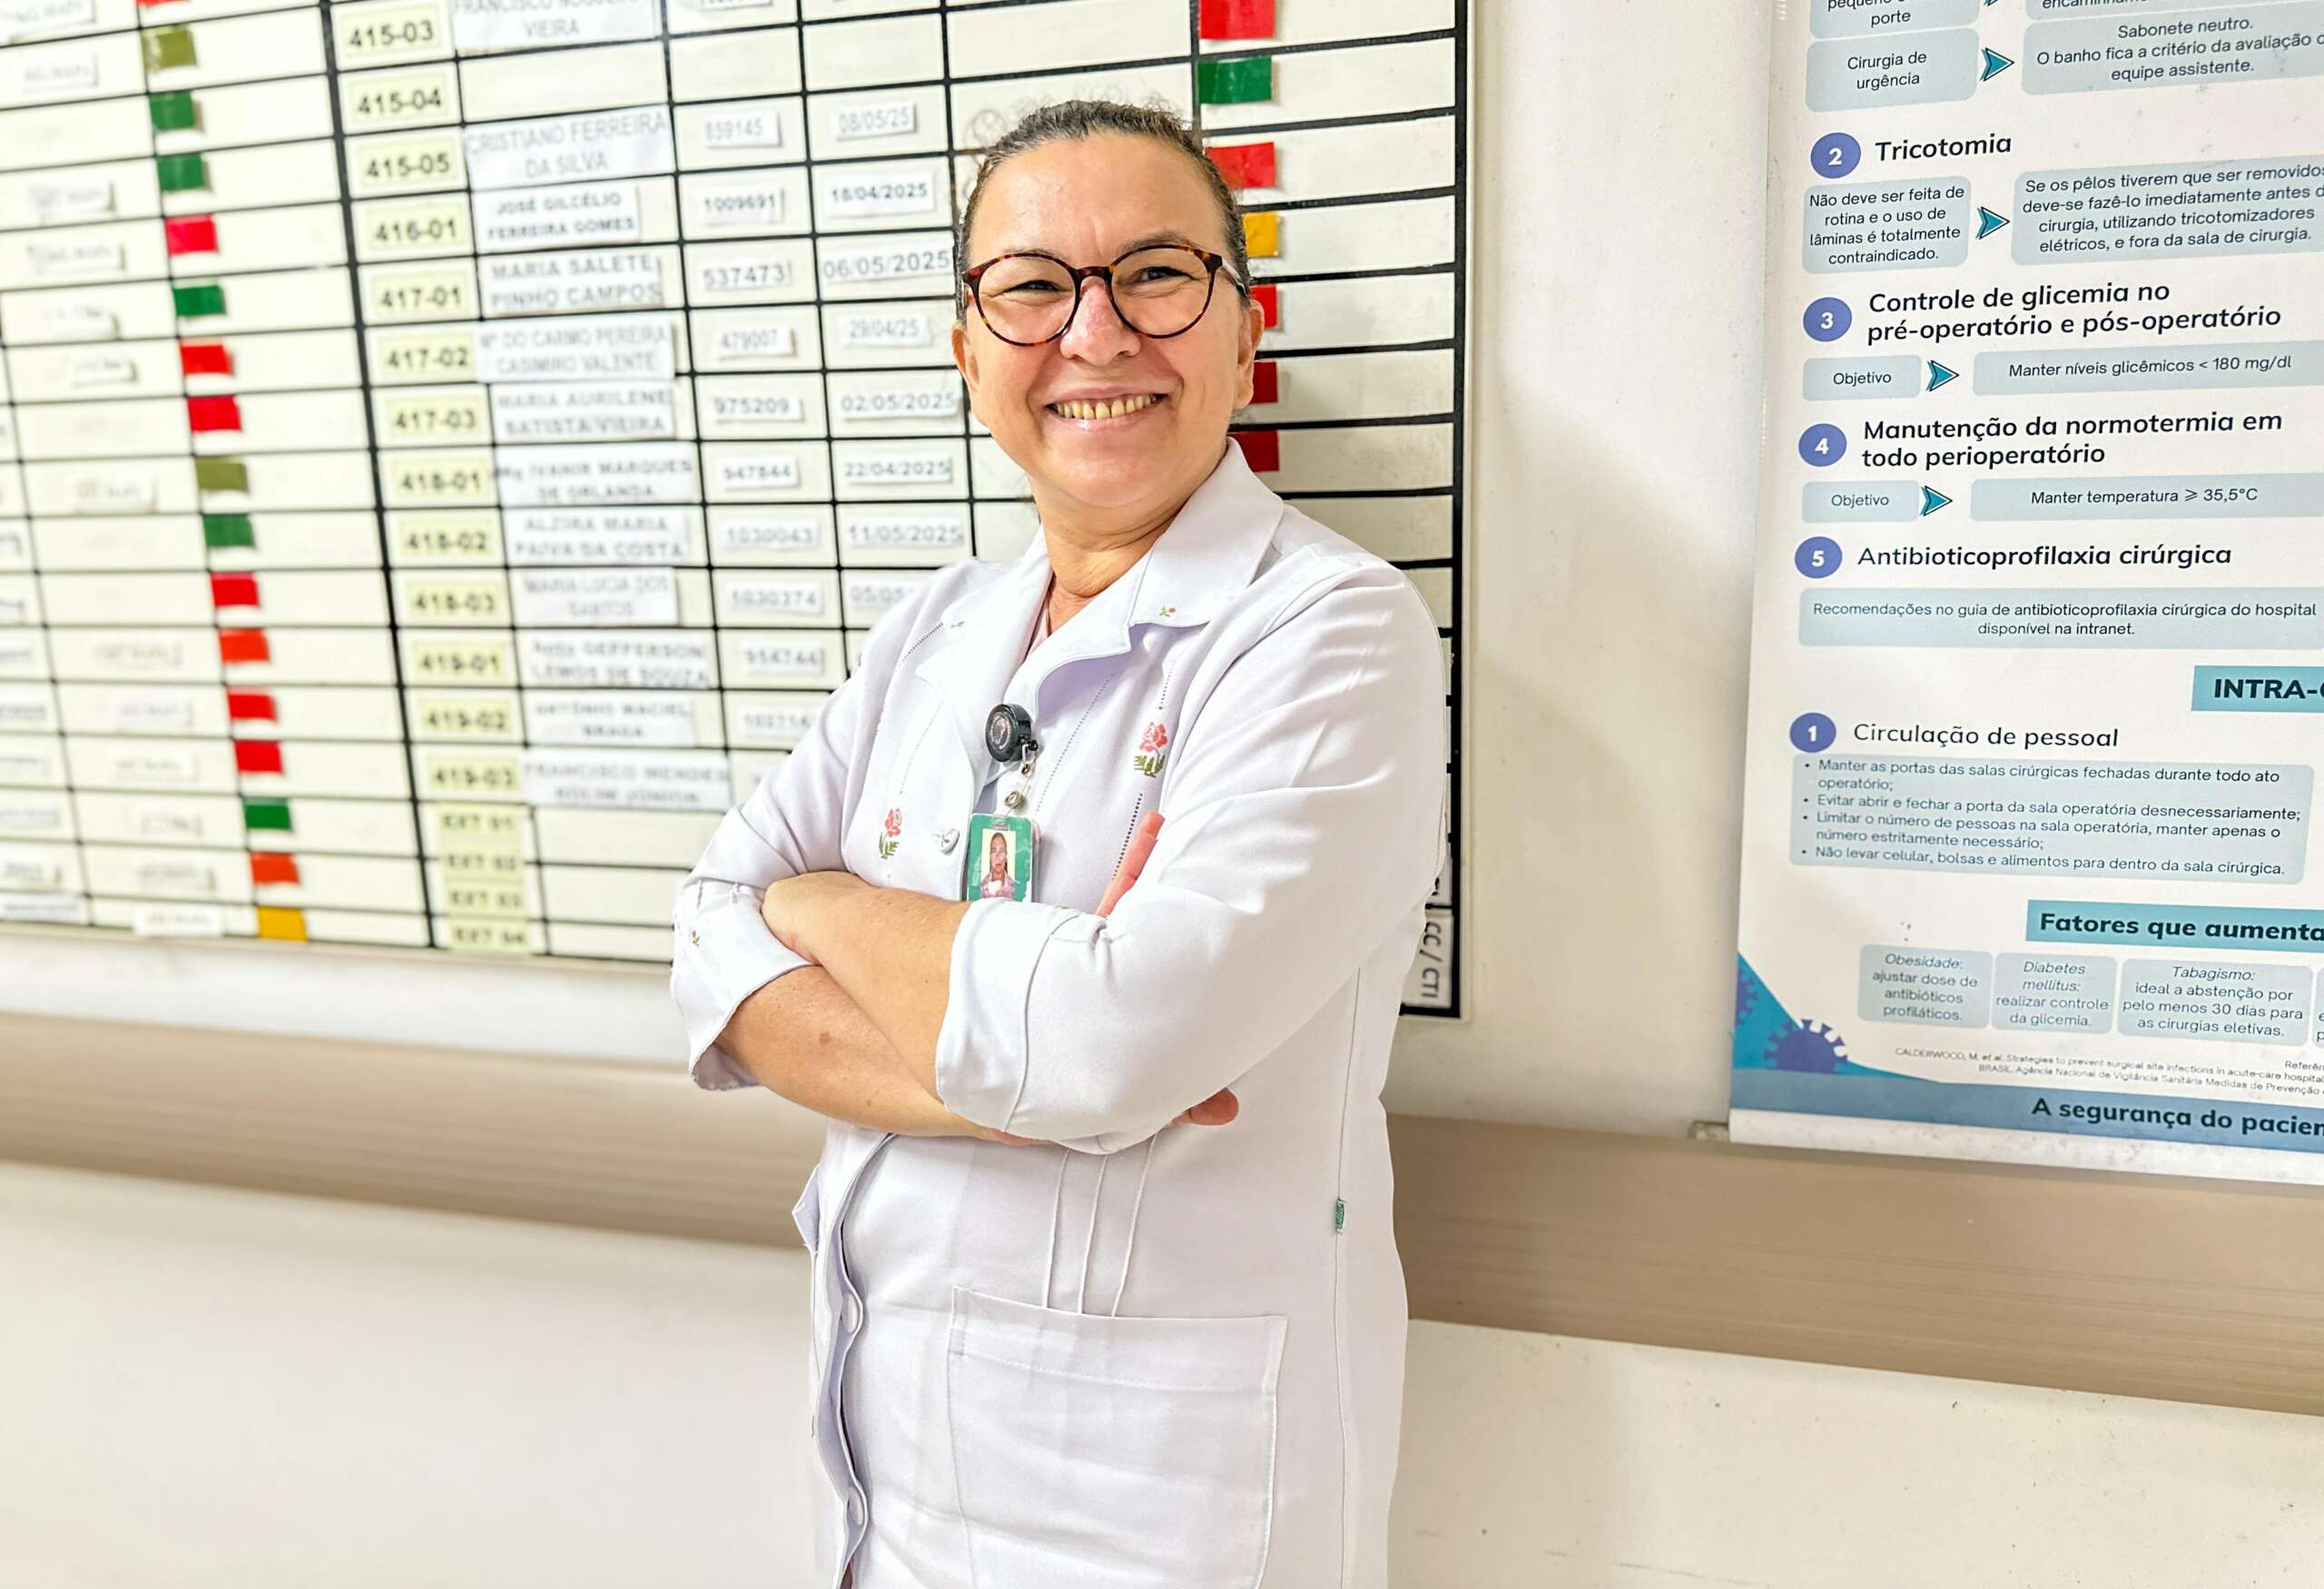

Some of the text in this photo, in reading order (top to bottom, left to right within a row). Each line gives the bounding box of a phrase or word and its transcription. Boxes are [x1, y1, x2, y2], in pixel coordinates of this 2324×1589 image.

[350, 20, 433, 47] 415-03
[2118, 18, 2253, 39] Sabonete neutro.
[2152, 43, 2206, 58] critério
[2235, 34, 2310, 51] avaliação
[1847, 54, 1903, 72] Cirurgia
[2112, 60, 2254, 83] equipe assistente.
[1856, 74, 1920, 91] urgência
[358, 89, 442, 115] 415-04
[1828, 133, 2012, 165] 2 Tricotomia
[366, 153, 449, 180] 415-05
[2122, 173, 2178, 187] tiverem
[1809, 188, 1941, 206] Não feita
[2023, 189, 2310, 212] deve-se fazê-lo imediatamente antes
[1825, 212, 1865, 225] rotina
[2039, 208, 2314, 233] cirurgia, utilizando tricotomizadores
[375, 219, 458, 242] 416-01
[1809, 228, 1960, 246] lâminas totalmente
[2040, 227, 2311, 252] elétricos, cirurgia.
[823, 251, 950, 279] 06/05/2025
[1828, 249, 1938, 264] contraindicado.
[381, 287, 461, 308] 417-01
[1821, 282, 2128, 329] 3 Controle glicemia
[1867, 305, 2281, 345] pré-operatório pós-operatório
[387, 346, 469, 370] 417-02
[2009, 357, 2240, 376] Manter níveis glicêmicos 180
[1833, 371, 1891, 387] Objetivo
[396, 410, 477, 429] 417-03
[1815, 411, 2233, 454] 4 Manutenção normotermia
[1926, 443, 2105, 470] perioperatório
[1831, 495, 1889, 508] Objetivo
[2032, 488, 2258, 505] Manter temperatura 35,5°C
[1812, 544, 2231, 569] 5 Antibioticoprofilaxia cirúrgica
[1814, 604, 2316, 618] Recomendações antibioticoprofilaxia cirúrgica hospital
[1978, 623, 2134, 636] disponível intranet.
[2214, 679, 2324, 699] INTRA-
[1808, 724, 2118, 749] 1 Circulação pessoal
[1819, 760, 2211, 781] Manter portas cirúrgicas fechadas durante
[1818, 779, 1893, 791] operatório;
[1817, 794, 2300, 821] Evitar fechar operatória desnecessariamente;
[1817, 813, 2266, 839] Limitar número pessoas operatória, manter apenas
[1817, 830, 2043, 850] número estritamente necessário;
[1816, 846, 2285, 876] Não celular, bolsas alimentos dentro cirúrgica.
[2041, 913, 2139, 934] Fatores
[1886, 953, 1963, 970] Obesidade:
[2024, 962, 2085, 974] Diabetes
[1422, 968, 1440, 998] CTI
[1872, 972, 1917, 984] ajustar
[2172, 966, 2256, 982] Tabagismo:
[1885, 988, 1964, 1003] antibióticos
[2023, 980, 2081, 992] mellitus:
[2187, 987, 2263, 1000] abstenção
[1883, 1005, 1962, 1022] profiláticos.
[1997, 996, 2109, 1011] realizar controle
[2211, 1003, 2230, 1015] 30
[2031, 1013, 2091, 1027] glicemia.
[2158, 1018, 2284, 1037] cirurgias eletivas.
[2007, 1054, 2053, 1064] Strategies
[2068, 1058, 2103, 1068] prevent
[2107, 1061, 2143, 1070] surgical
[2167, 1063, 2213, 1074] infections
[2228, 1068, 2281, 1080] acute-care
[2056, 1069, 2094, 1078] Nacional
[2060, 1103, 2191, 1129] segurança
